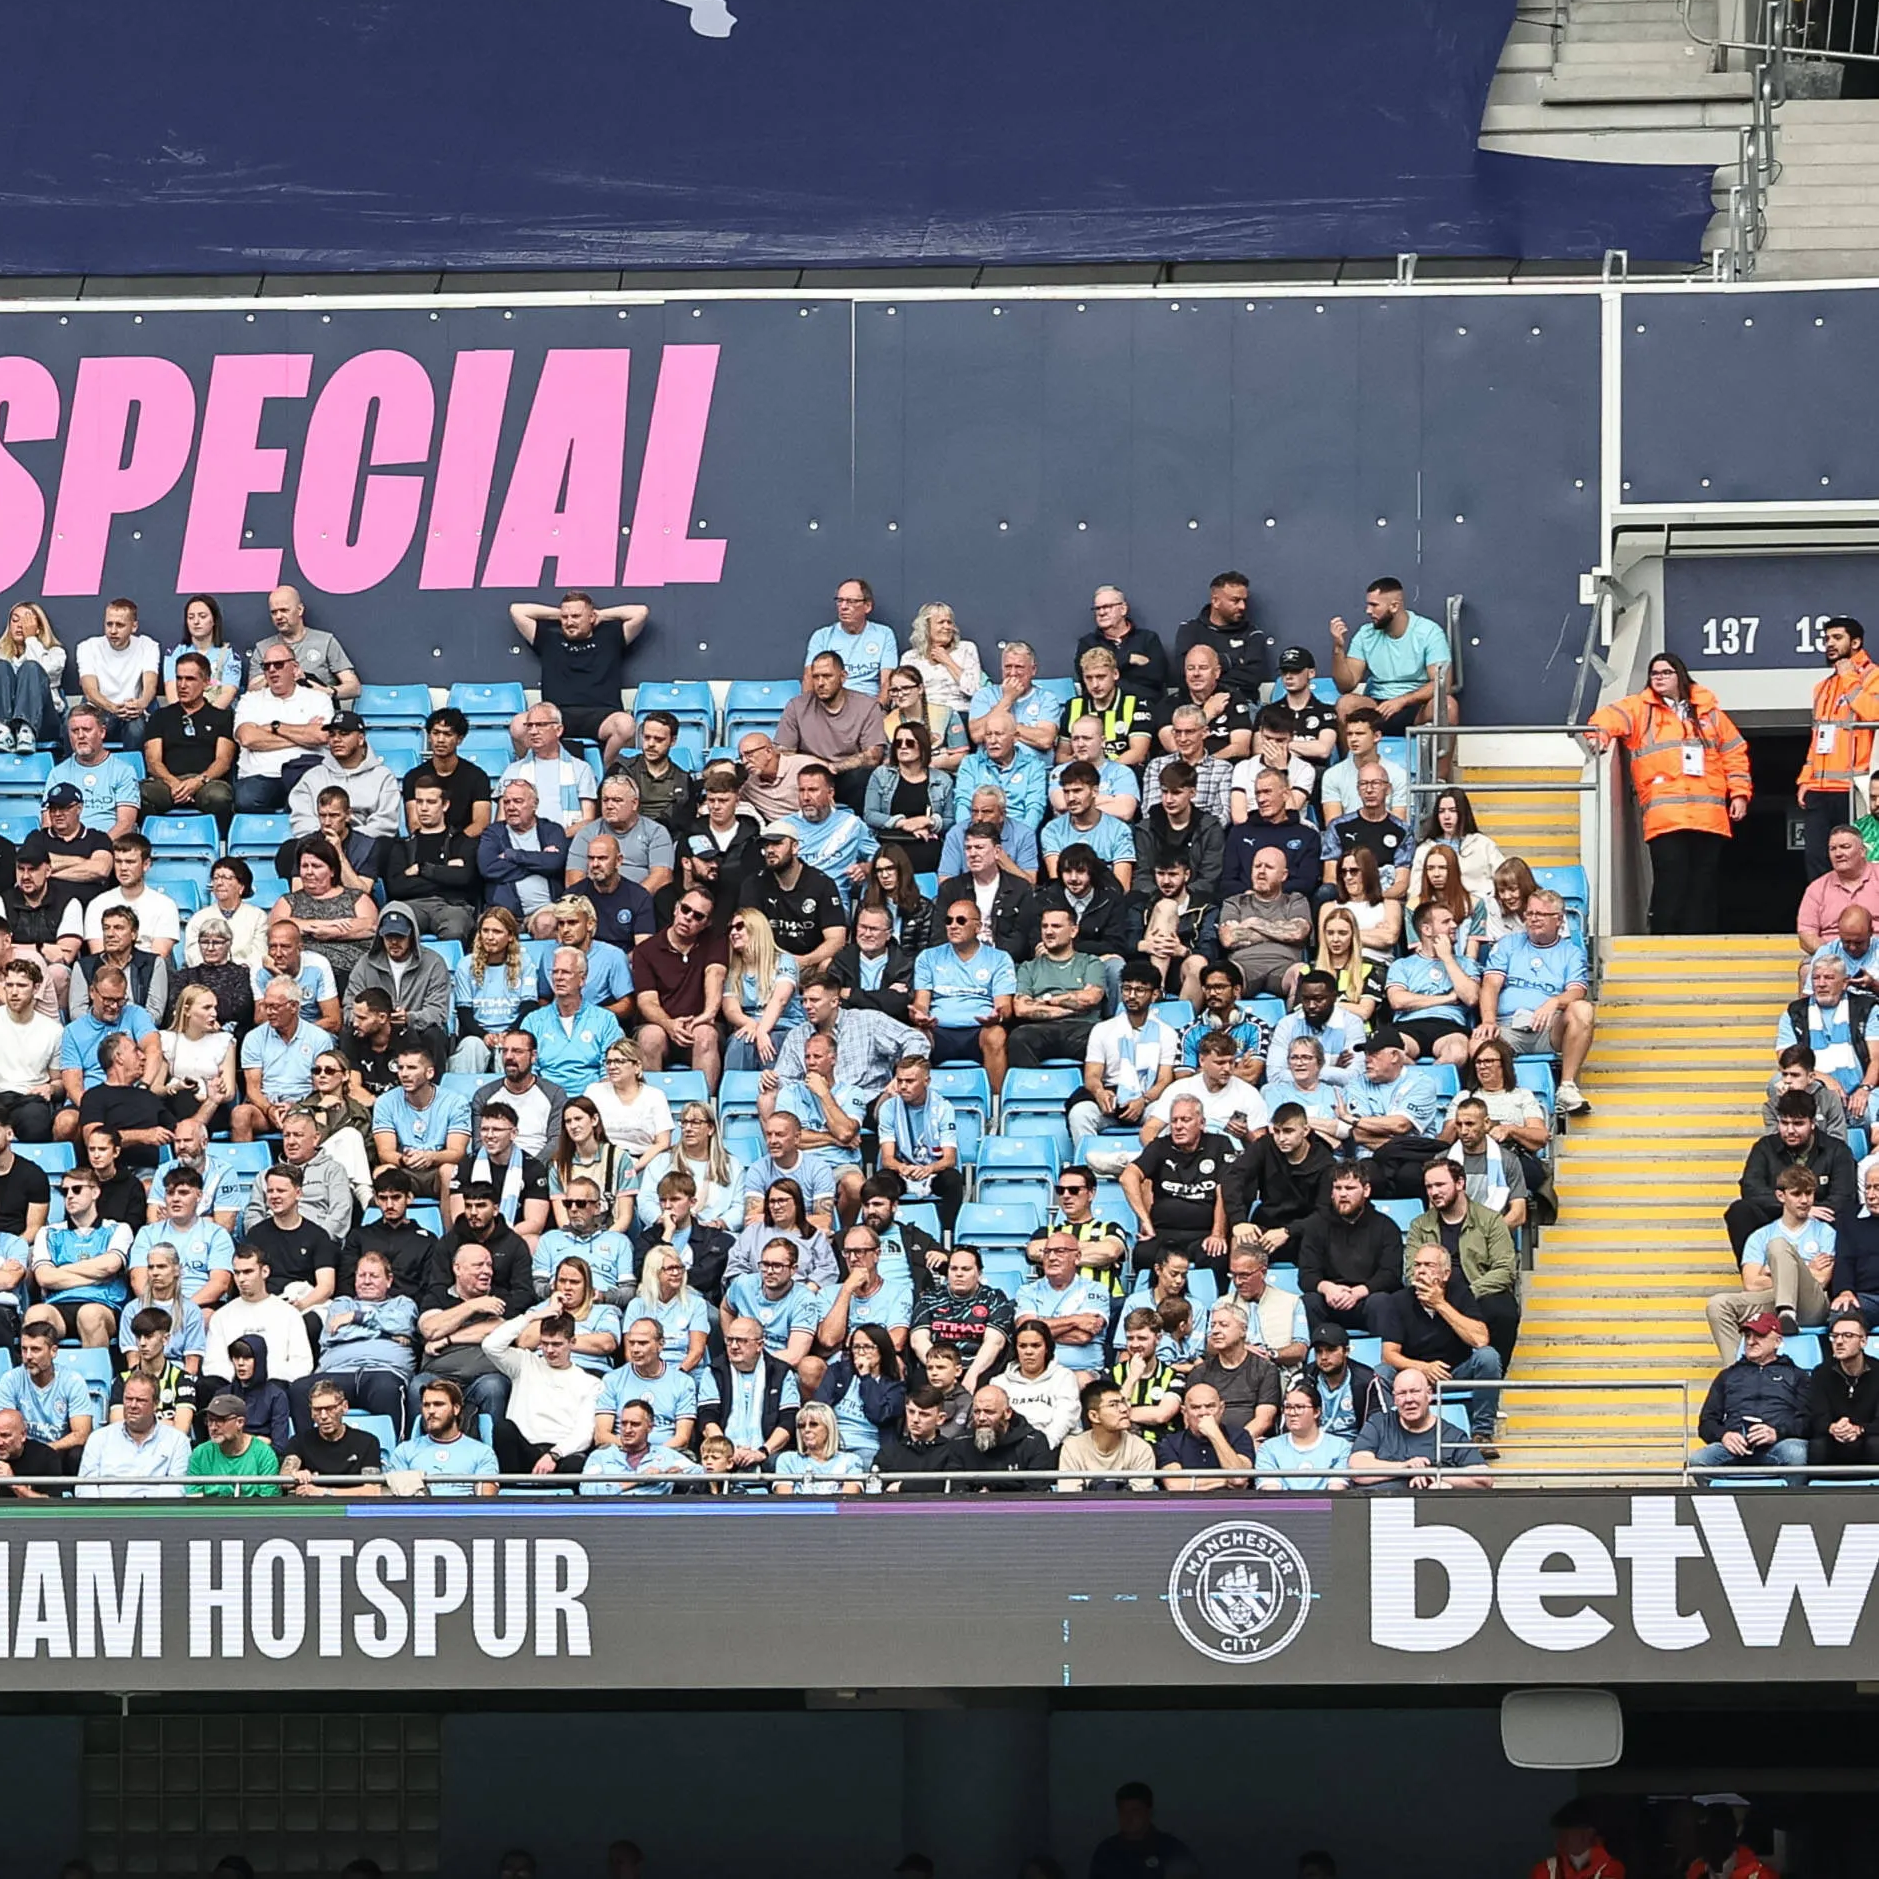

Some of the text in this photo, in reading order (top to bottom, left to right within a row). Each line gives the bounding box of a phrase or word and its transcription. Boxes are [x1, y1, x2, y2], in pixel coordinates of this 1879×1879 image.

[1701, 615, 1848, 656] 137 13
[1505, 977, 1557, 994] ETIHAD
[1161, 1180, 1217, 1194] ETIHAD
[931, 1321, 986, 1333] ETIHAD
[1184, 1532, 1295, 1576] MANCHESTER
[1370, 1495, 1879, 1653] betw
[188, 1537, 593, 1660] HOTSPUR
[1220, 1638, 1261, 1651] CITY
